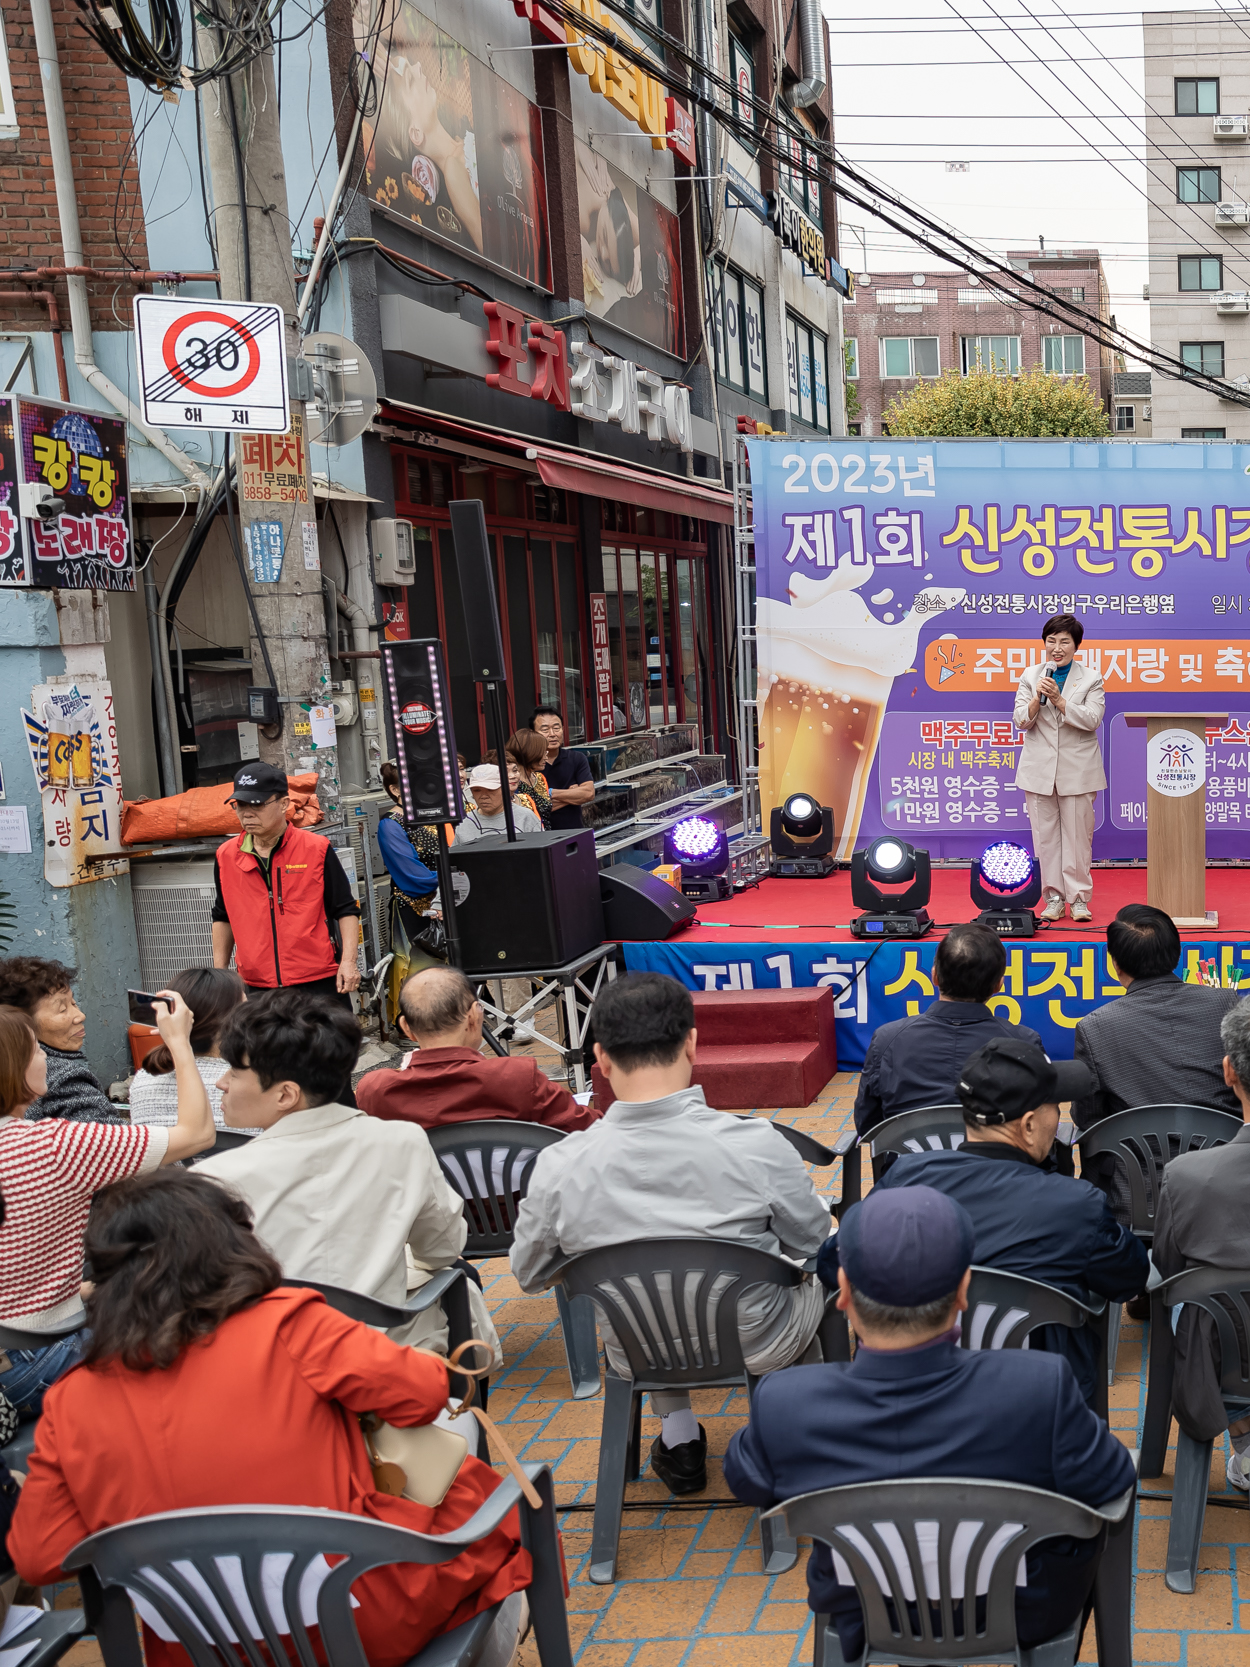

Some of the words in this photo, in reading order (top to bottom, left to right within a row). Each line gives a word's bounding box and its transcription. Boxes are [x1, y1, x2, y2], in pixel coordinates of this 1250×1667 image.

[185, 337, 240, 372] 30
[184, 407, 203, 423] 해
[231, 410, 250, 425] 제
[33, 434, 116, 508] 캉캉
[782, 452, 937, 498] 2023년
[784, 506, 923, 568] 제1회
[913, 594, 947, 614] 장소
[960, 593, 1176, 615] 신성전통시장입구우리은행옆
[1211, 595, 1242, 615] 일시
[1178, 653, 1203, 684] 및
[54, 730, 83, 765] Cass
[908, 751, 936, 770] 시장
[941, 751, 954, 770] 내
[960, 751, 1015, 770] 맥주축제
[890, 775, 939, 799] 5천원
[943, 775, 1000, 798] 영수증
[1158, 782, 1177, 791] SINCE
[892, 801, 940, 824] 1만원
[945, 800, 1001, 823] 영수증
